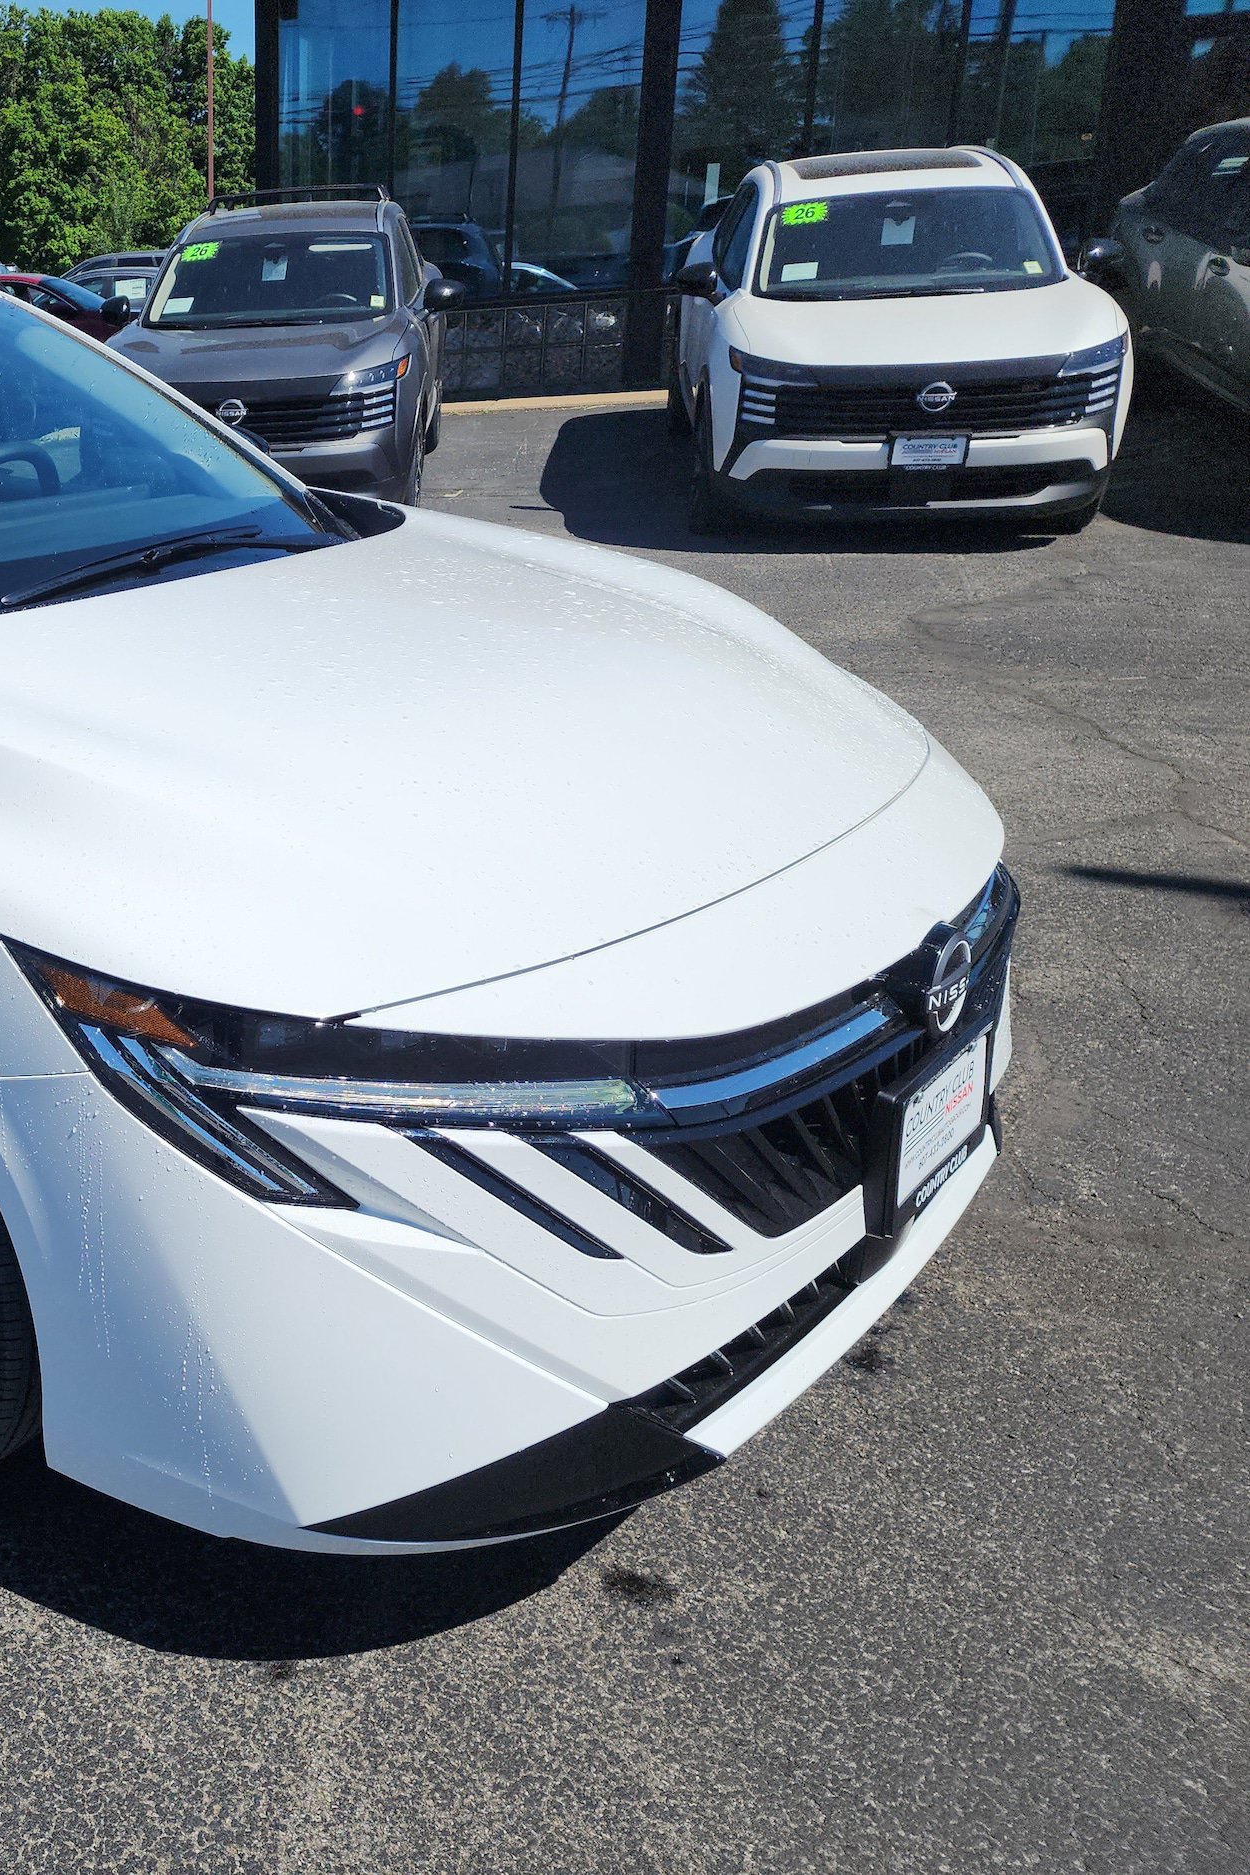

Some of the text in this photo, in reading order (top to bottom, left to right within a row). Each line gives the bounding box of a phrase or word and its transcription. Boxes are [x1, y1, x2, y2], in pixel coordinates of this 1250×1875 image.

[794, 206, 816, 220] 26
[190, 245, 210, 258] 26
[917, 394, 956, 402] NISSAN
[216, 409, 246, 417] NISSAN
[928, 976, 969, 1011] NISS
[906, 1081, 952, 1138] COUNTRY
[952, 1060, 974, 1093] CLUB
[945, 1080, 974, 1115] NISSAN
[915, 1144, 968, 1208] COUNTRY CLUB
